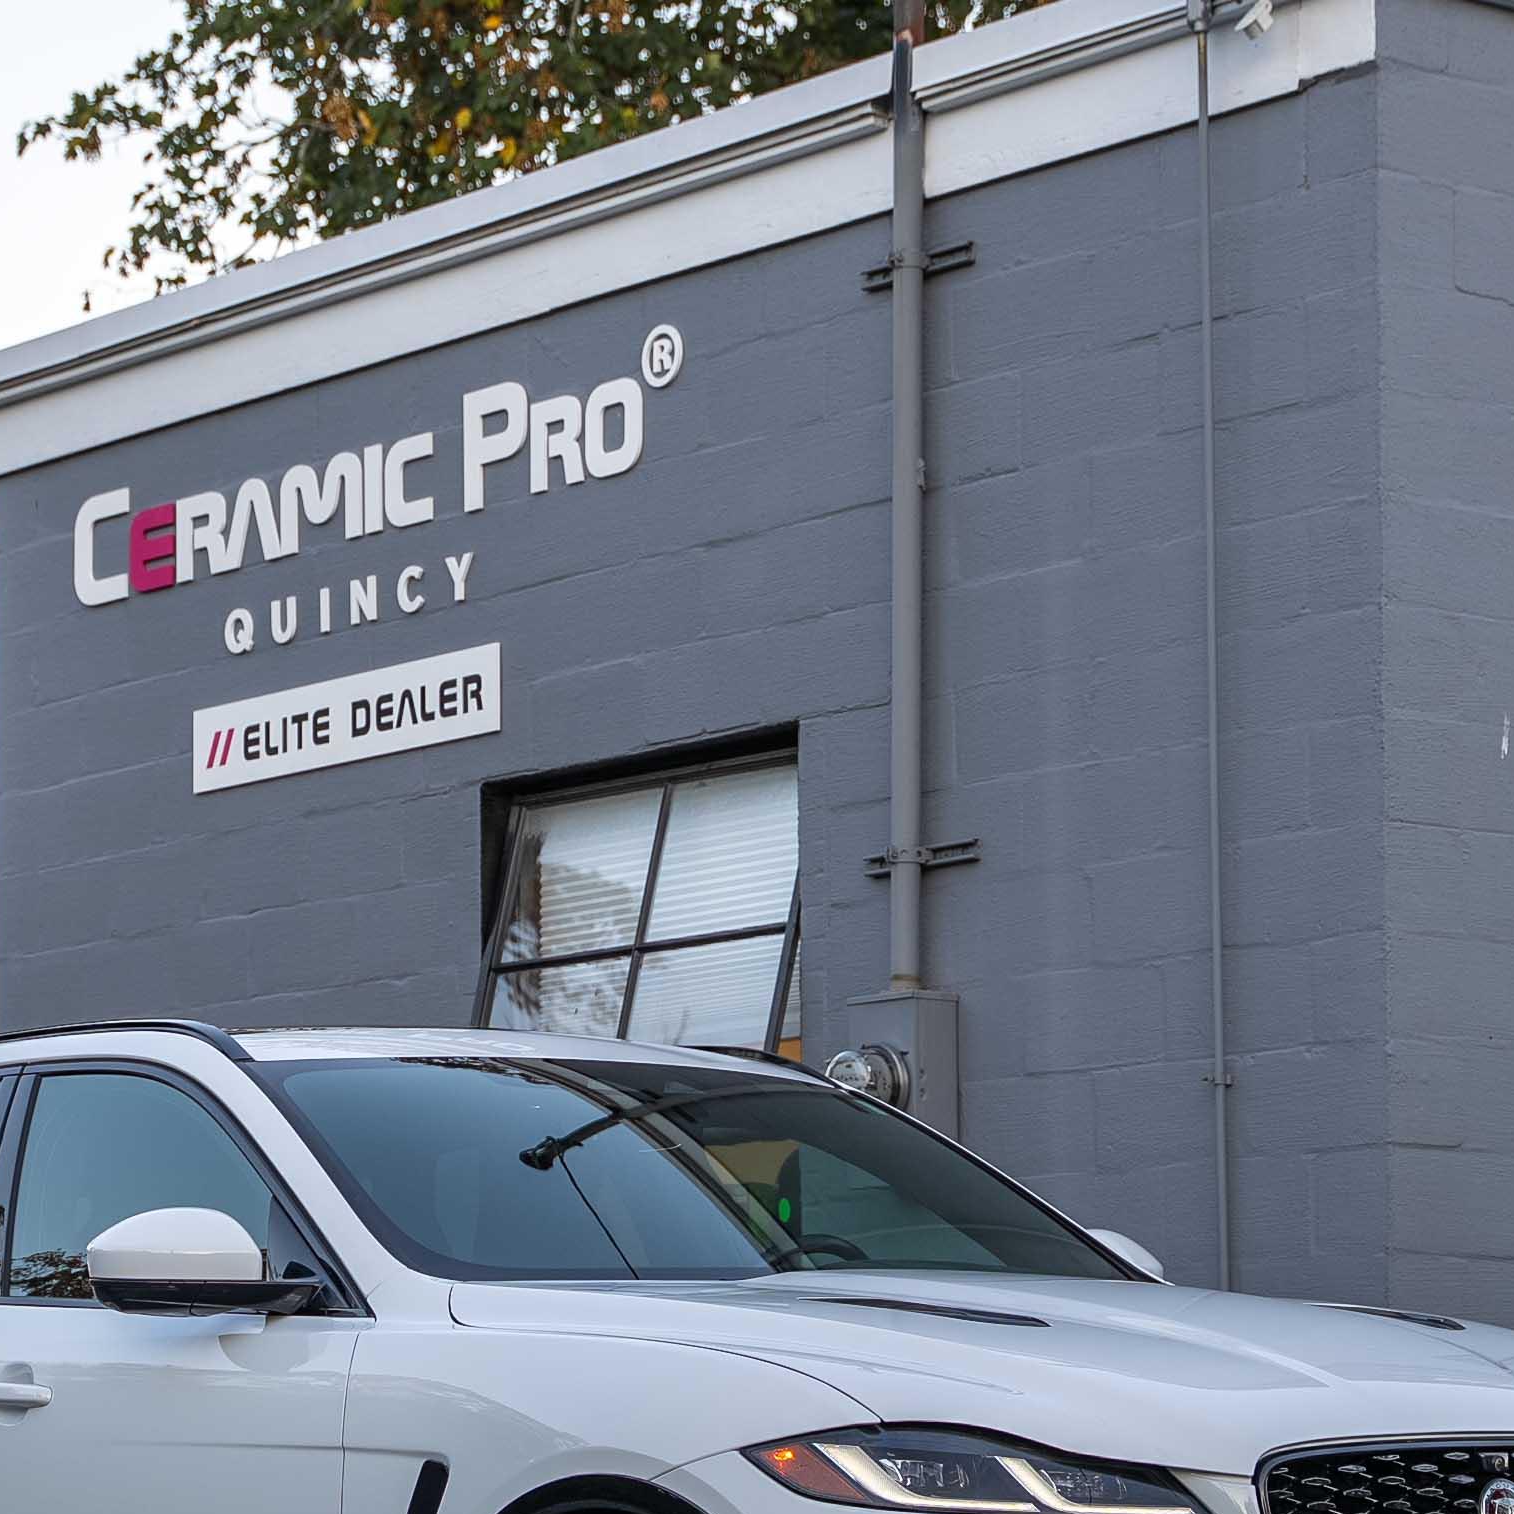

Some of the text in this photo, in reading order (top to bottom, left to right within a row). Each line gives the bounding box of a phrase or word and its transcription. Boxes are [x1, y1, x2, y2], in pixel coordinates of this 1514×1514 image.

[73, 431, 435, 608] CERAMIC
[224, 552, 474, 654] QUINCY
[243, 673, 484, 761] ELITE DEALER
